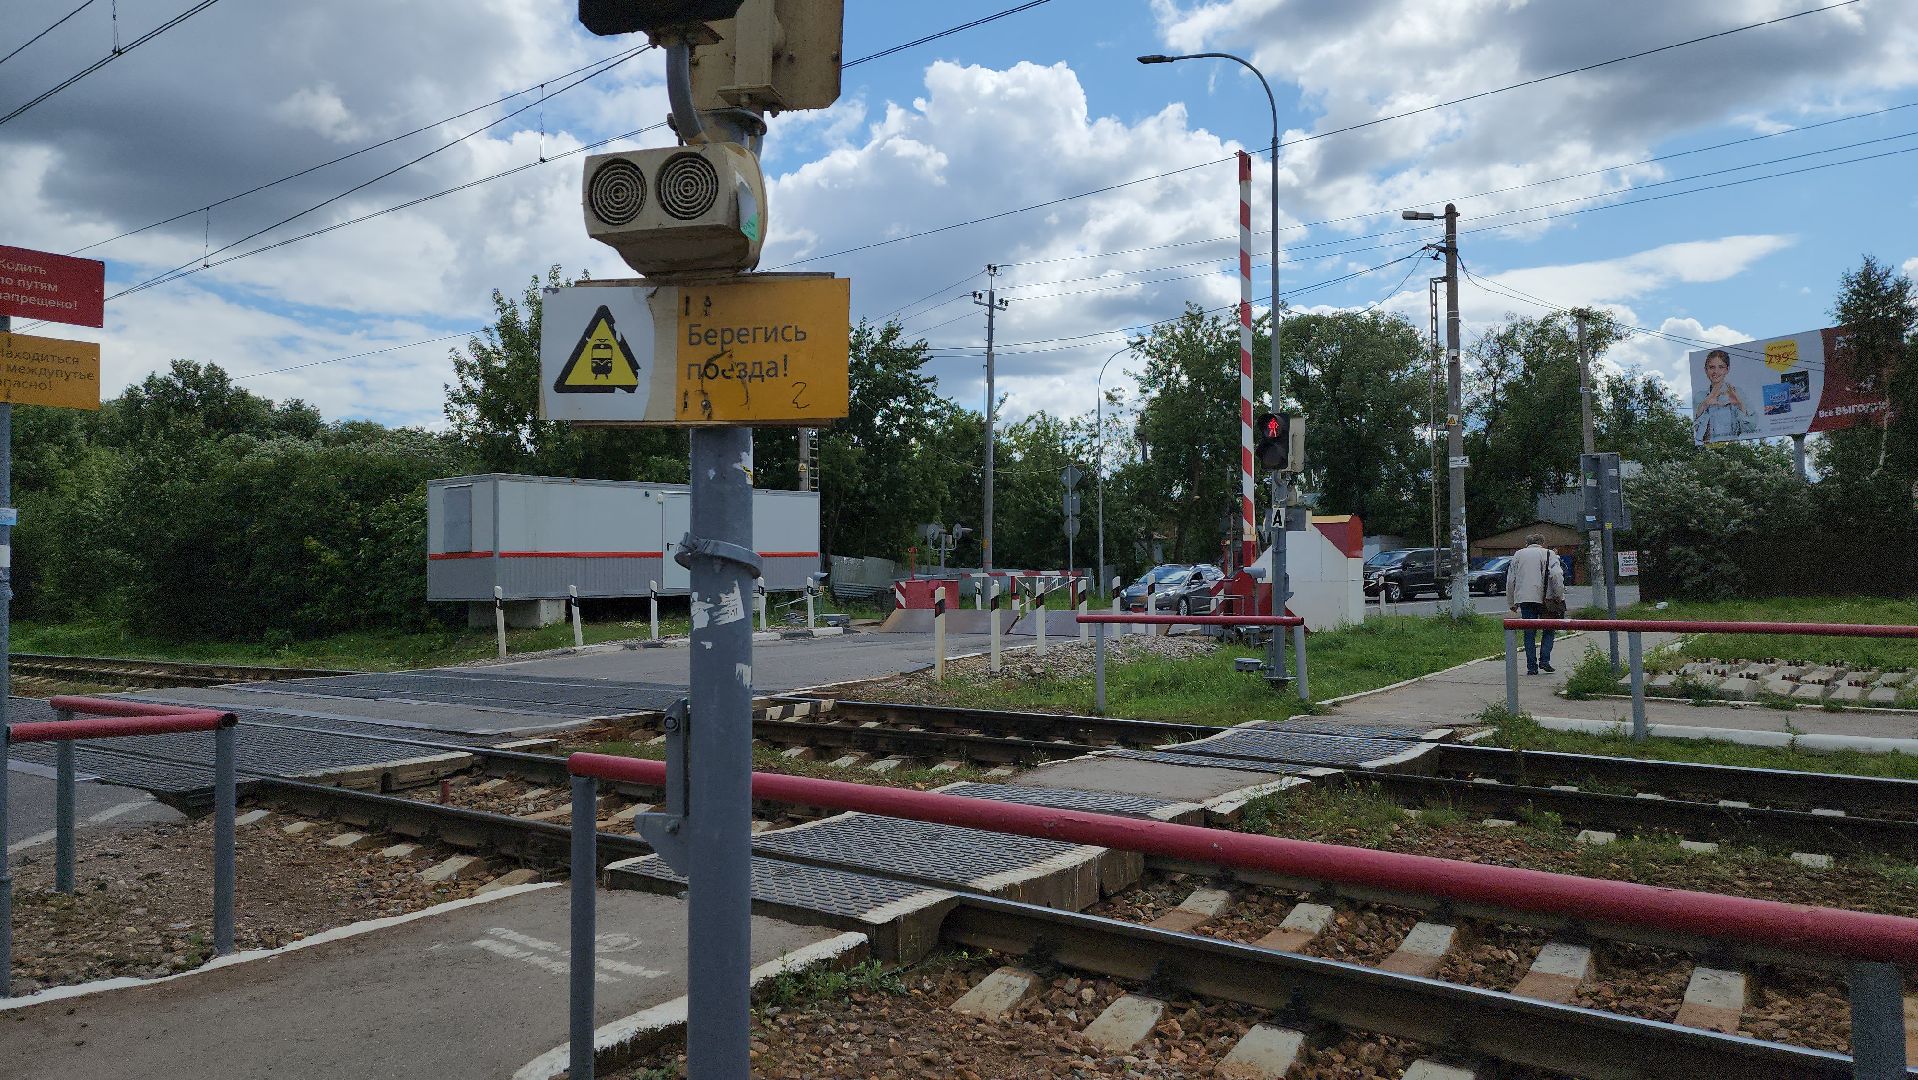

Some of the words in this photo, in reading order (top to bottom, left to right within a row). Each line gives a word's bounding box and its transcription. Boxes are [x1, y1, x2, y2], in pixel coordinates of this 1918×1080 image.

[17, 279, 58, 292] путям
[688, 323, 807, 352] Берегись
[6, 364, 95, 381] междупутье
[687, 354, 789, 383] поезда!
